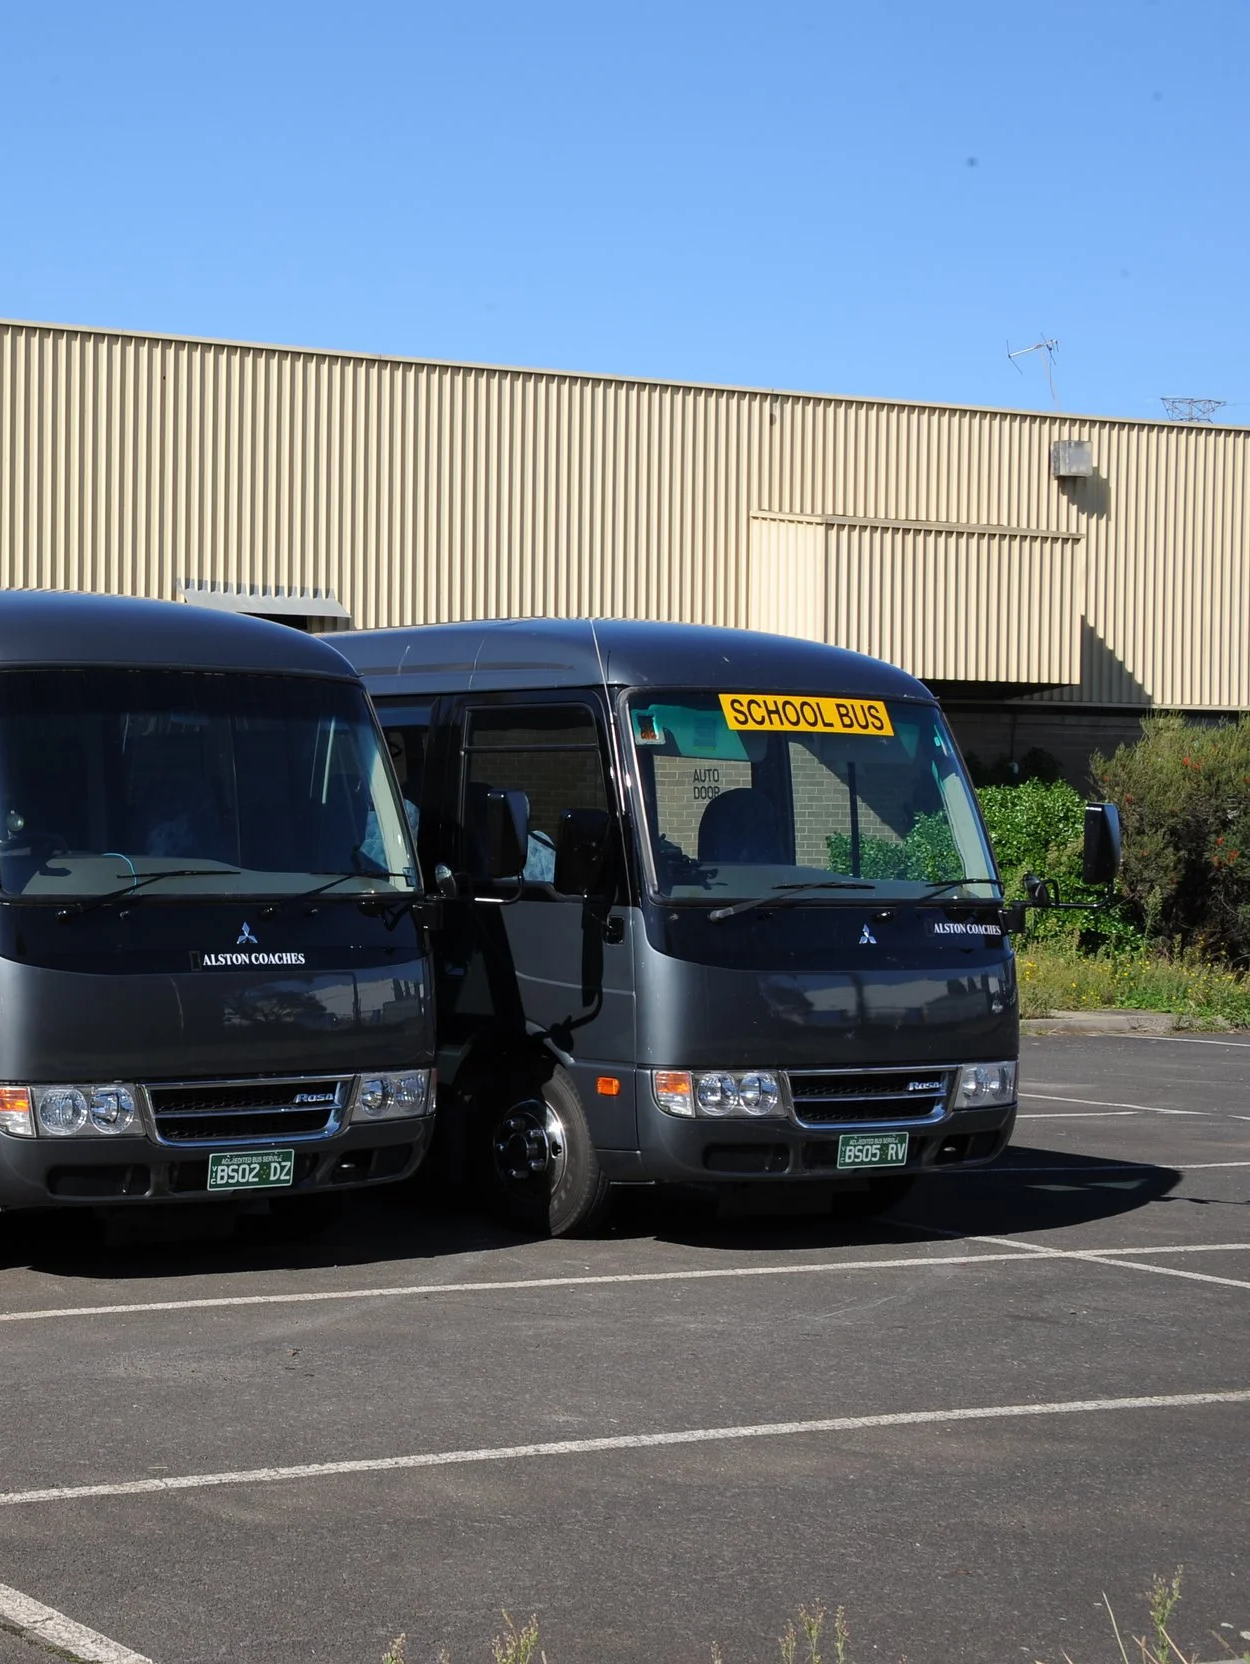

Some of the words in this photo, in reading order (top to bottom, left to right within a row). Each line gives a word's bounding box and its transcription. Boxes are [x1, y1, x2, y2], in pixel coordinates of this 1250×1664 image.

[730, 698, 834, 728] SCHOOL
[835, 703, 884, 731] BUS
[693, 768, 720, 783] AUTO
[693, 786, 721, 800] DOOR
[933, 922, 966, 934] ALSTON
[966, 923, 1002, 936] COACHES
[203, 952, 250, 966] ALSTON
[251, 952, 306, 965] COACHES
[845, 1144, 881, 1163] BS05
[887, 1143, 906, 1161] RV
[216, 1163, 260, 1185] BS02
[269, 1161, 292, 1181] DZ
